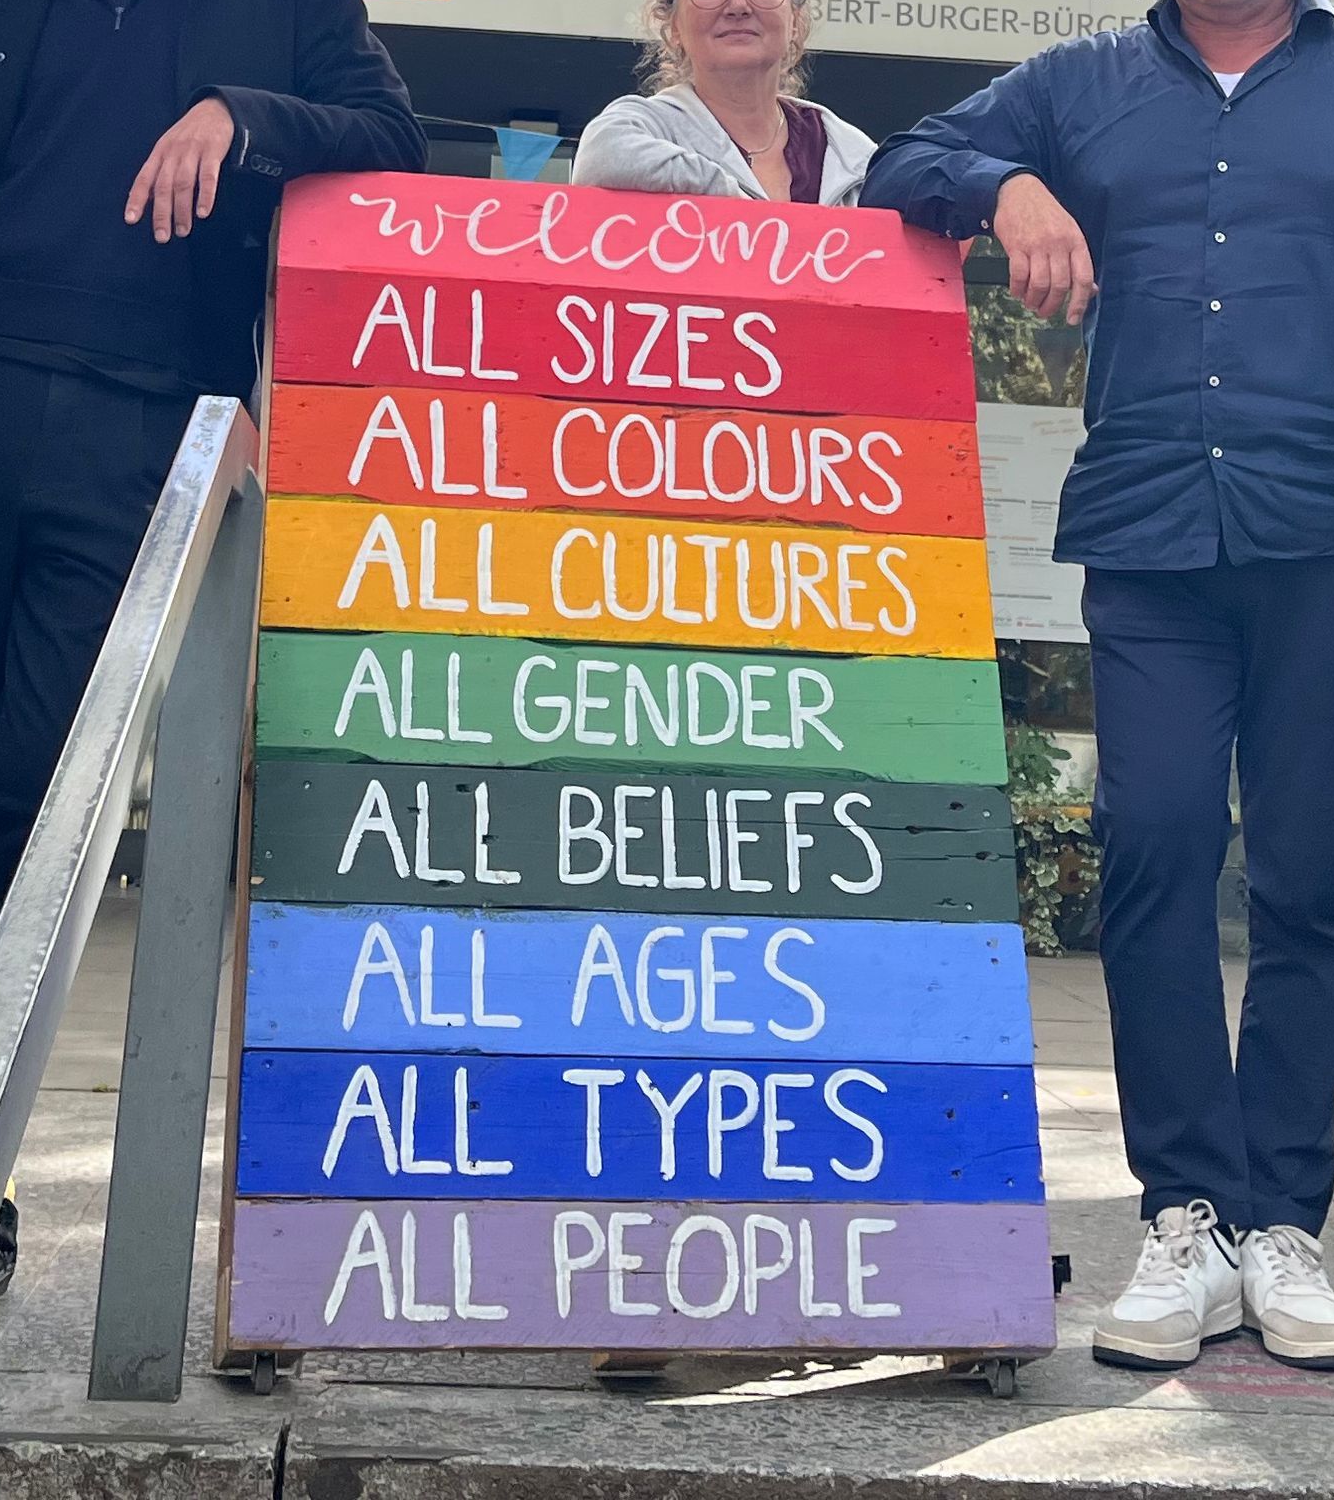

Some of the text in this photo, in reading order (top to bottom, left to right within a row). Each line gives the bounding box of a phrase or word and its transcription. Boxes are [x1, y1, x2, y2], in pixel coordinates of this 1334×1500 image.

[350, 190, 885, 285] welcome
[351, 283, 783, 398] ALL SIZES
[347, 394, 903, 515] ALL COLOURS
[337, 513, 917, 636] ALL CULTURES
[334, 646, 845, 752] ALL GENDER
[337, 778, 883, 895] ALL BELIEFS
[342, 921, 826, 1043] ALL AGES
[322, 1064, 888, 1182] ALL TYPES
[323, 1209, 903, 1326] ALL PEOPLE
